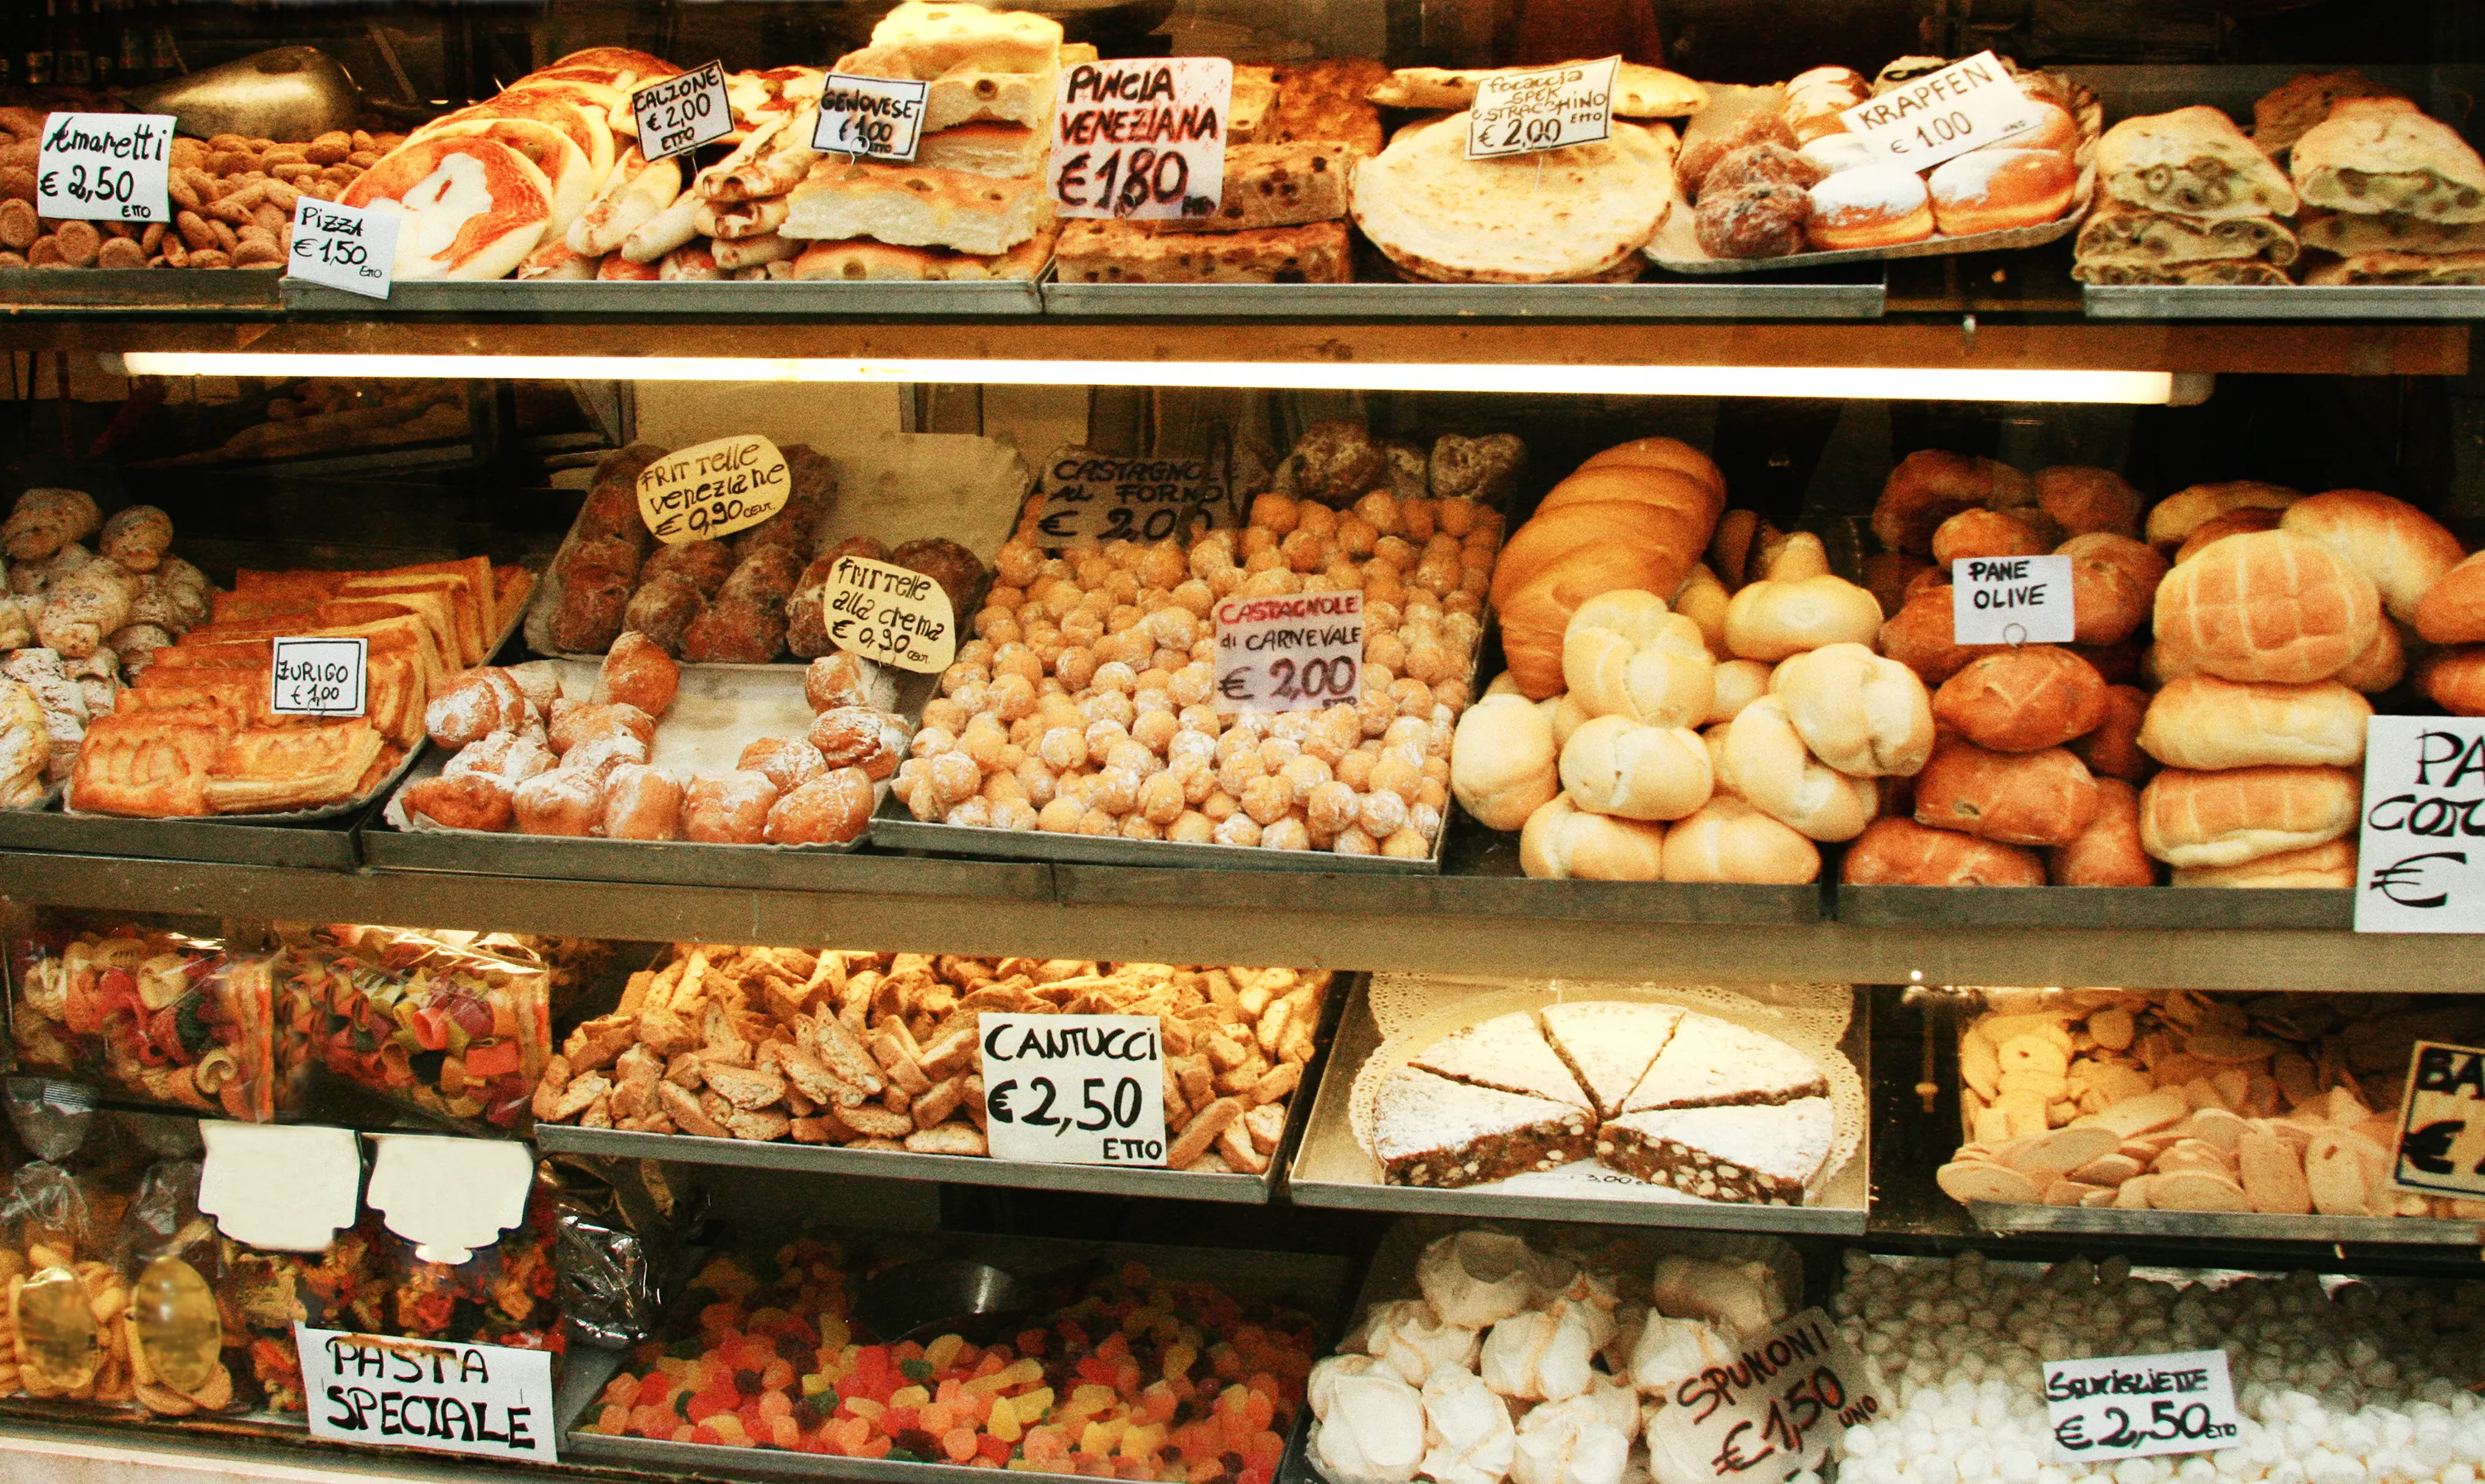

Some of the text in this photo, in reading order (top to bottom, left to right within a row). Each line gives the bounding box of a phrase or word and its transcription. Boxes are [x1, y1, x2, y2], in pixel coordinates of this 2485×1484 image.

[634, 68, 719, 112] CALZONE
[1067, 65, 1175, 104] PINCIA
[1504, 87, 1562, 105] SPEK
[1858, 62, 1994, 130] KRAPFEN
[821, 89, 921, 118] GENOVESE
[44, 116, 166, 161] Amaretti
[661, 127, 694, 151] ETTO
[1060, 104, 1218, 145] VENEZIANA
[68, 165, 134, 203] 2,50
[121, 205, 151, 218] ETTO
[359, 266, 382, 277] ETTO
[1115, 484, 1223, 504] FORNO
[689, 499, 743, 535] 0,90
[1968, 561, 2029, 581] PANE
[1219, 595, 1359, 625] CASTAGNOLE
[1974, 584, 2047, 610] OLIVE
[832, 590, 944, 641] alla crema
[1220, 625, 1361, 650] di CARNEVALE
[277, 660, 348, 683] ZURIGO
[2370, 852, 2467, 908] €
[1103, 1137, 1162, 1159] ETTO
[325, 1336, 489, 1383] PASTA
[1677, 1322, 1830, 1425] SPUMONI
[326, 1385, 535, 1449] SPECIALE
[1837, 1395, 1877, 1429] UNO
